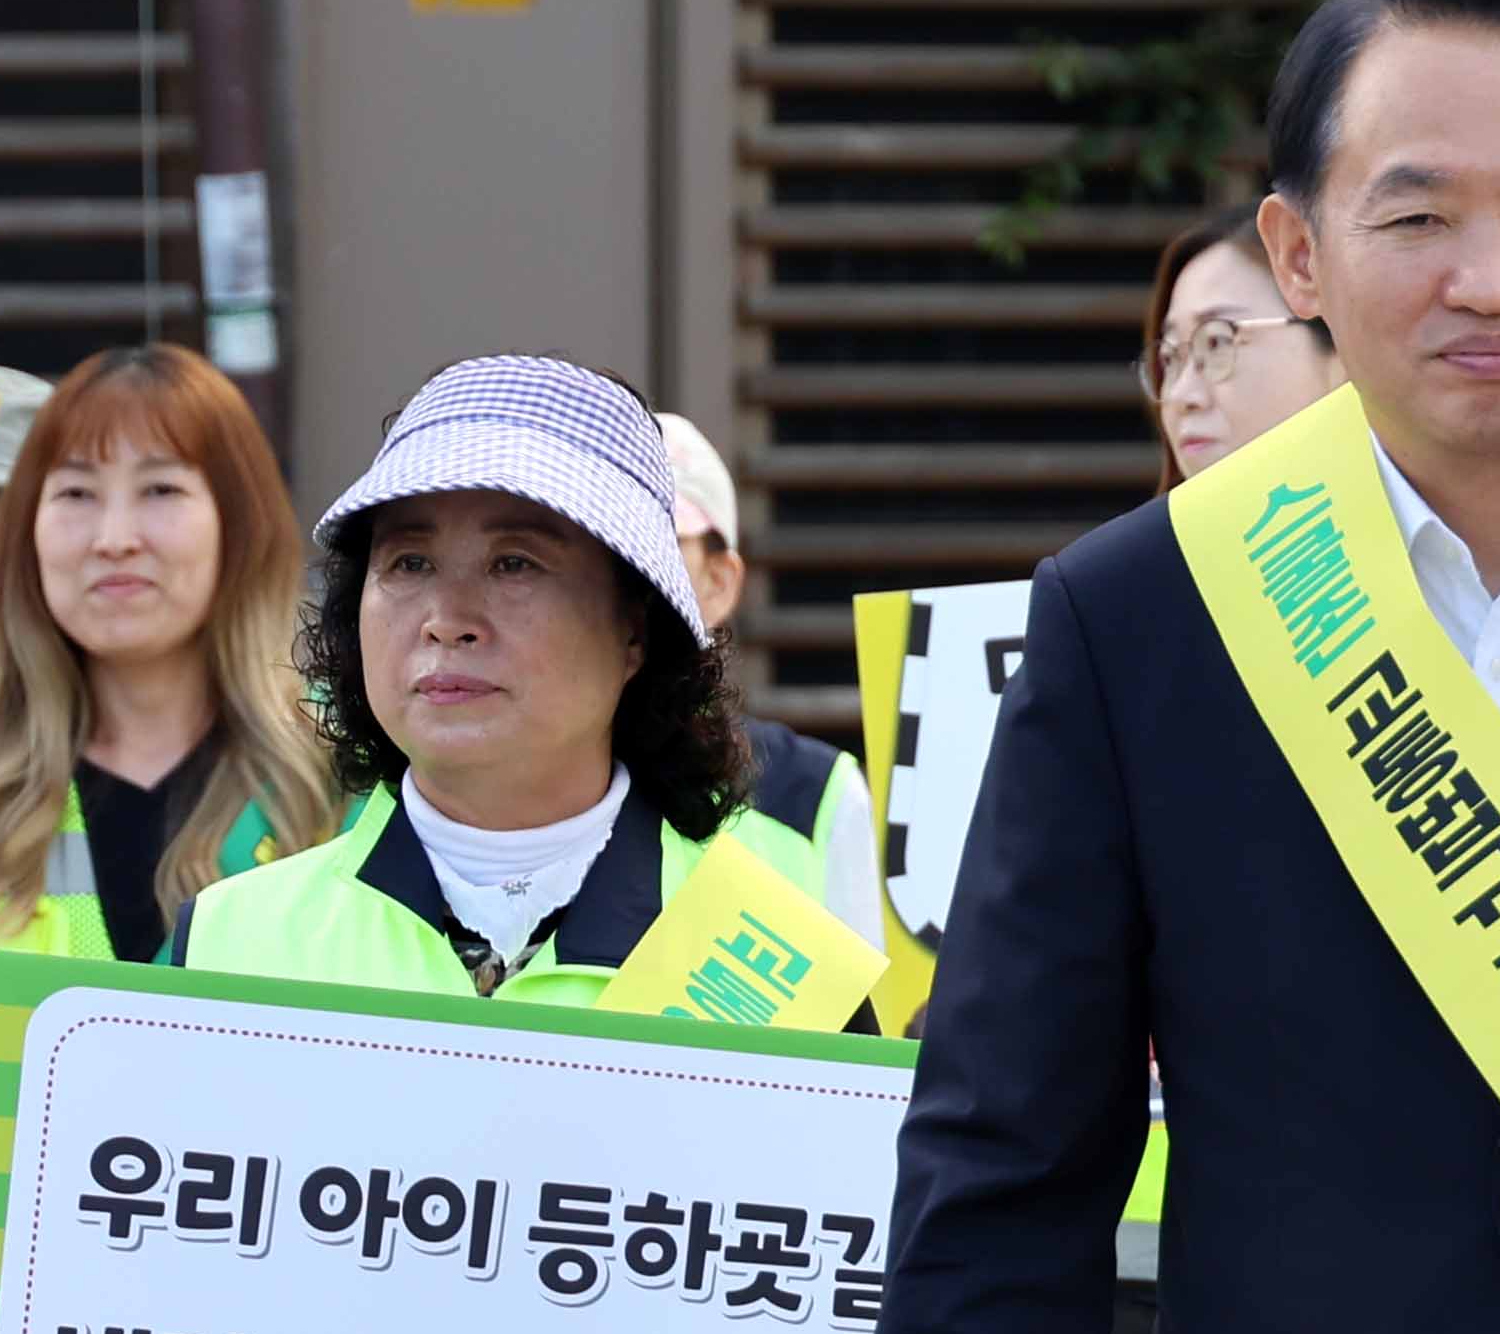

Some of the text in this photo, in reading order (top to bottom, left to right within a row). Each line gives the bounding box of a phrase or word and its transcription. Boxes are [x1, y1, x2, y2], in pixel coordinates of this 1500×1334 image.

[1243, 482, 1375, 679] 스쿨존
[78, 1136, 269, 1246] 우리
[298, 1167, 497, 1269] 아이
